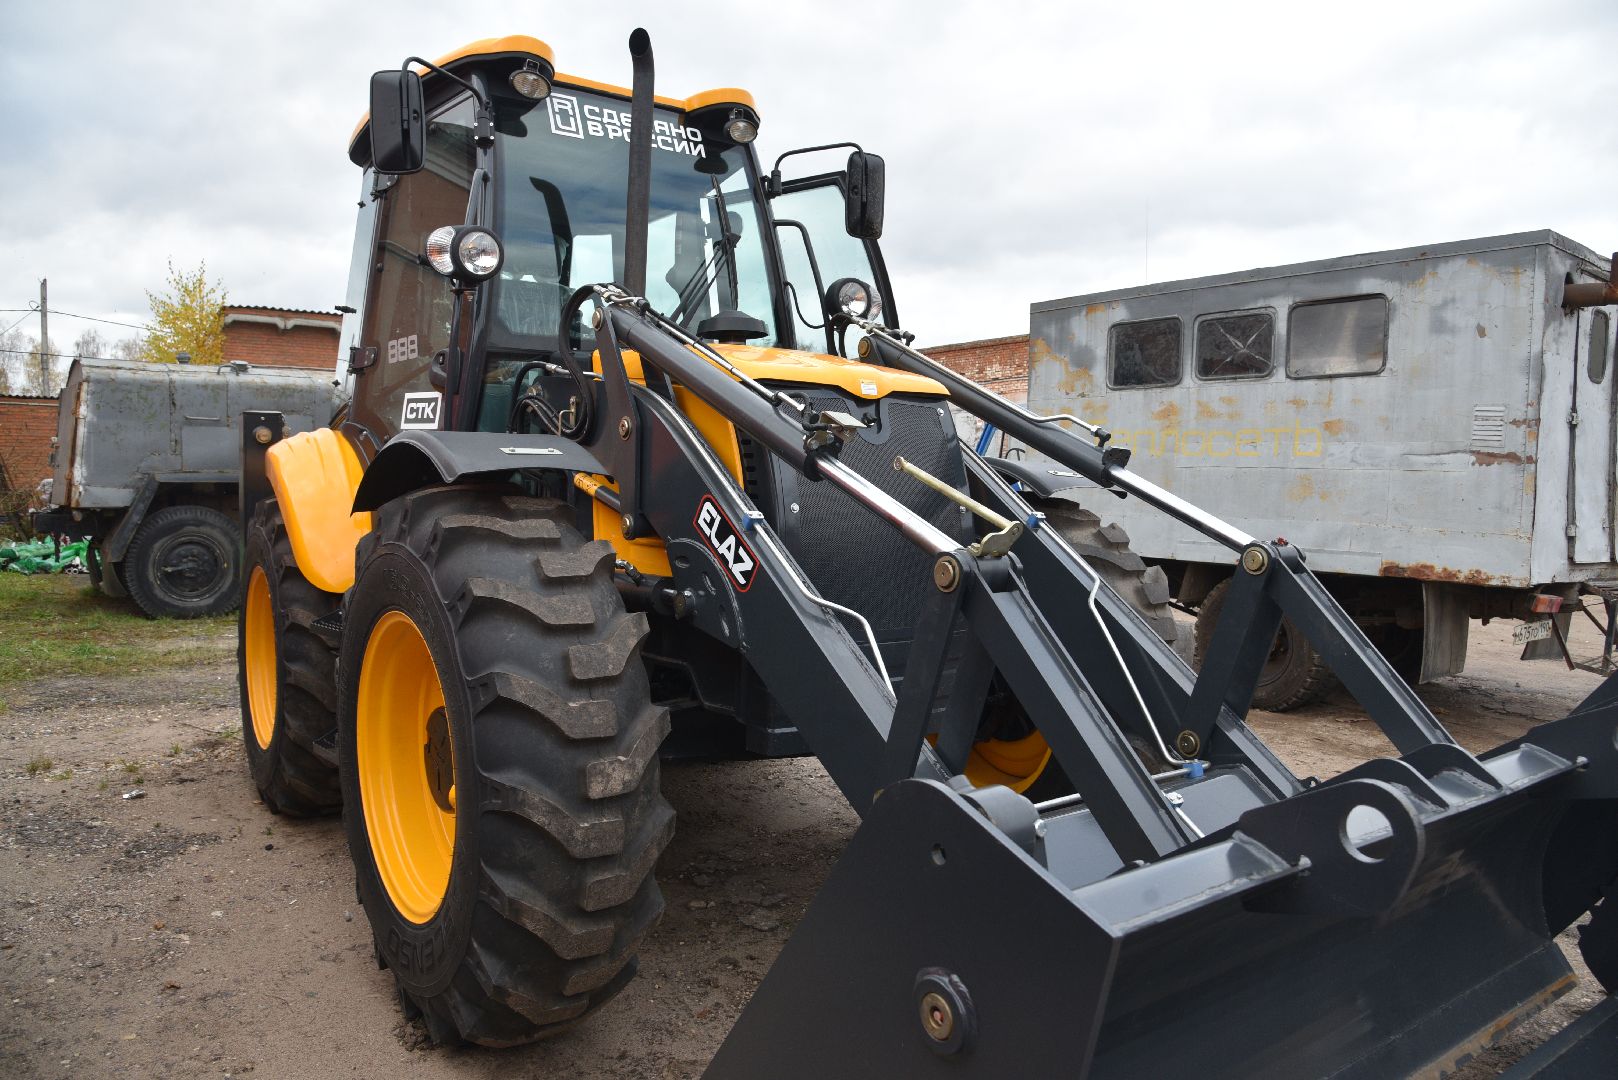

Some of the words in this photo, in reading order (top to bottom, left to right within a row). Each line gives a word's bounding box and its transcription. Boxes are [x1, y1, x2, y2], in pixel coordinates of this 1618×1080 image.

[583, 104, 703, 142] СДЕАНО
[586, 120, 605, 137] В
[605, 123, 707, 159] РСИИ
[697, 501, 754, 585] ELAZ
